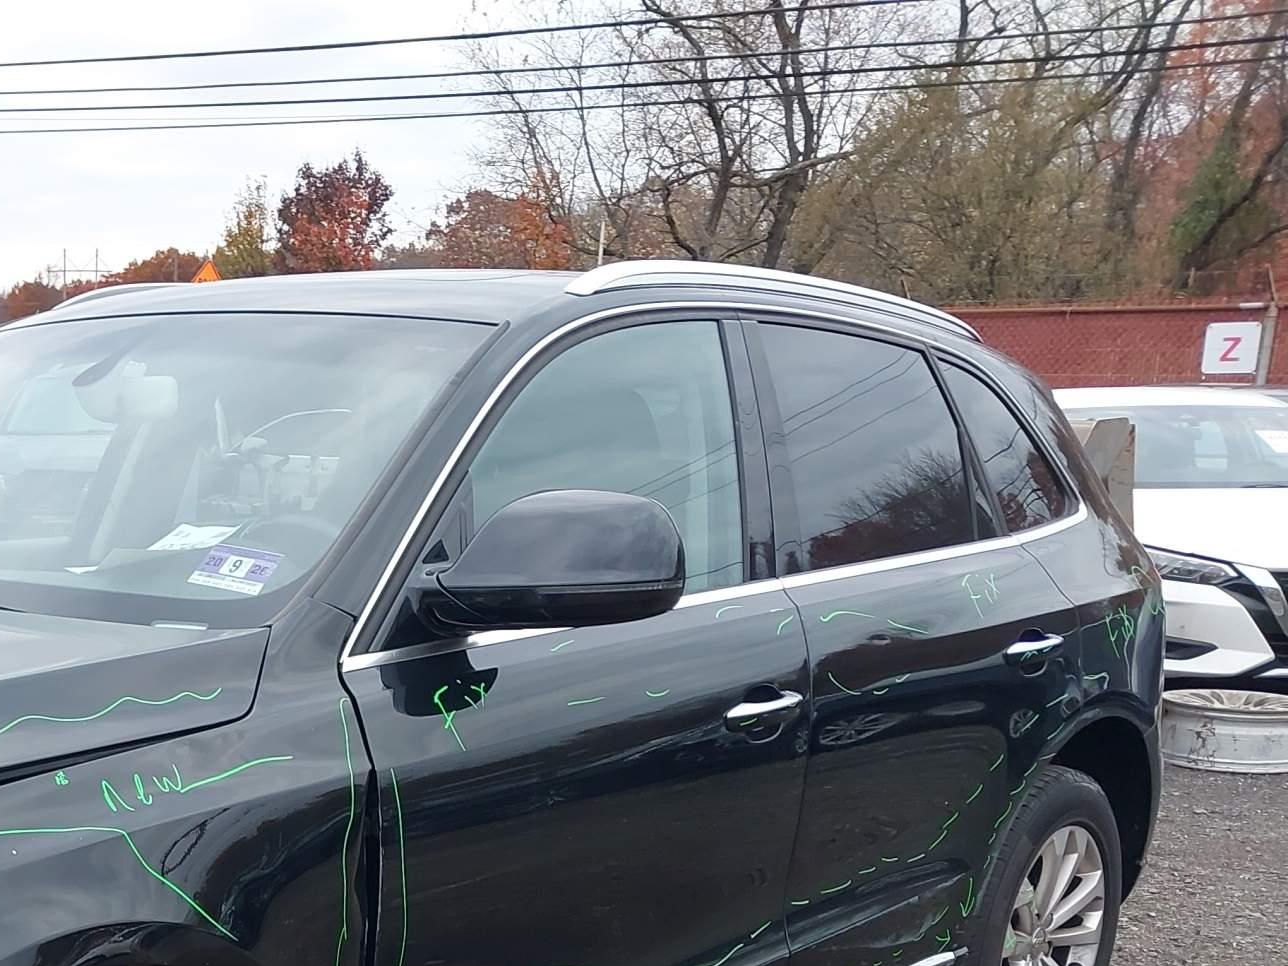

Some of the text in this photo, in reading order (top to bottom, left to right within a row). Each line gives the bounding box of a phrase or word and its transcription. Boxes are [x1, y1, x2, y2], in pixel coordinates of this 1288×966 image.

[1219, 336, 1243, 362] Z
[205, 556, 224, 567] 20
[228, 559, 244, 574] 9
